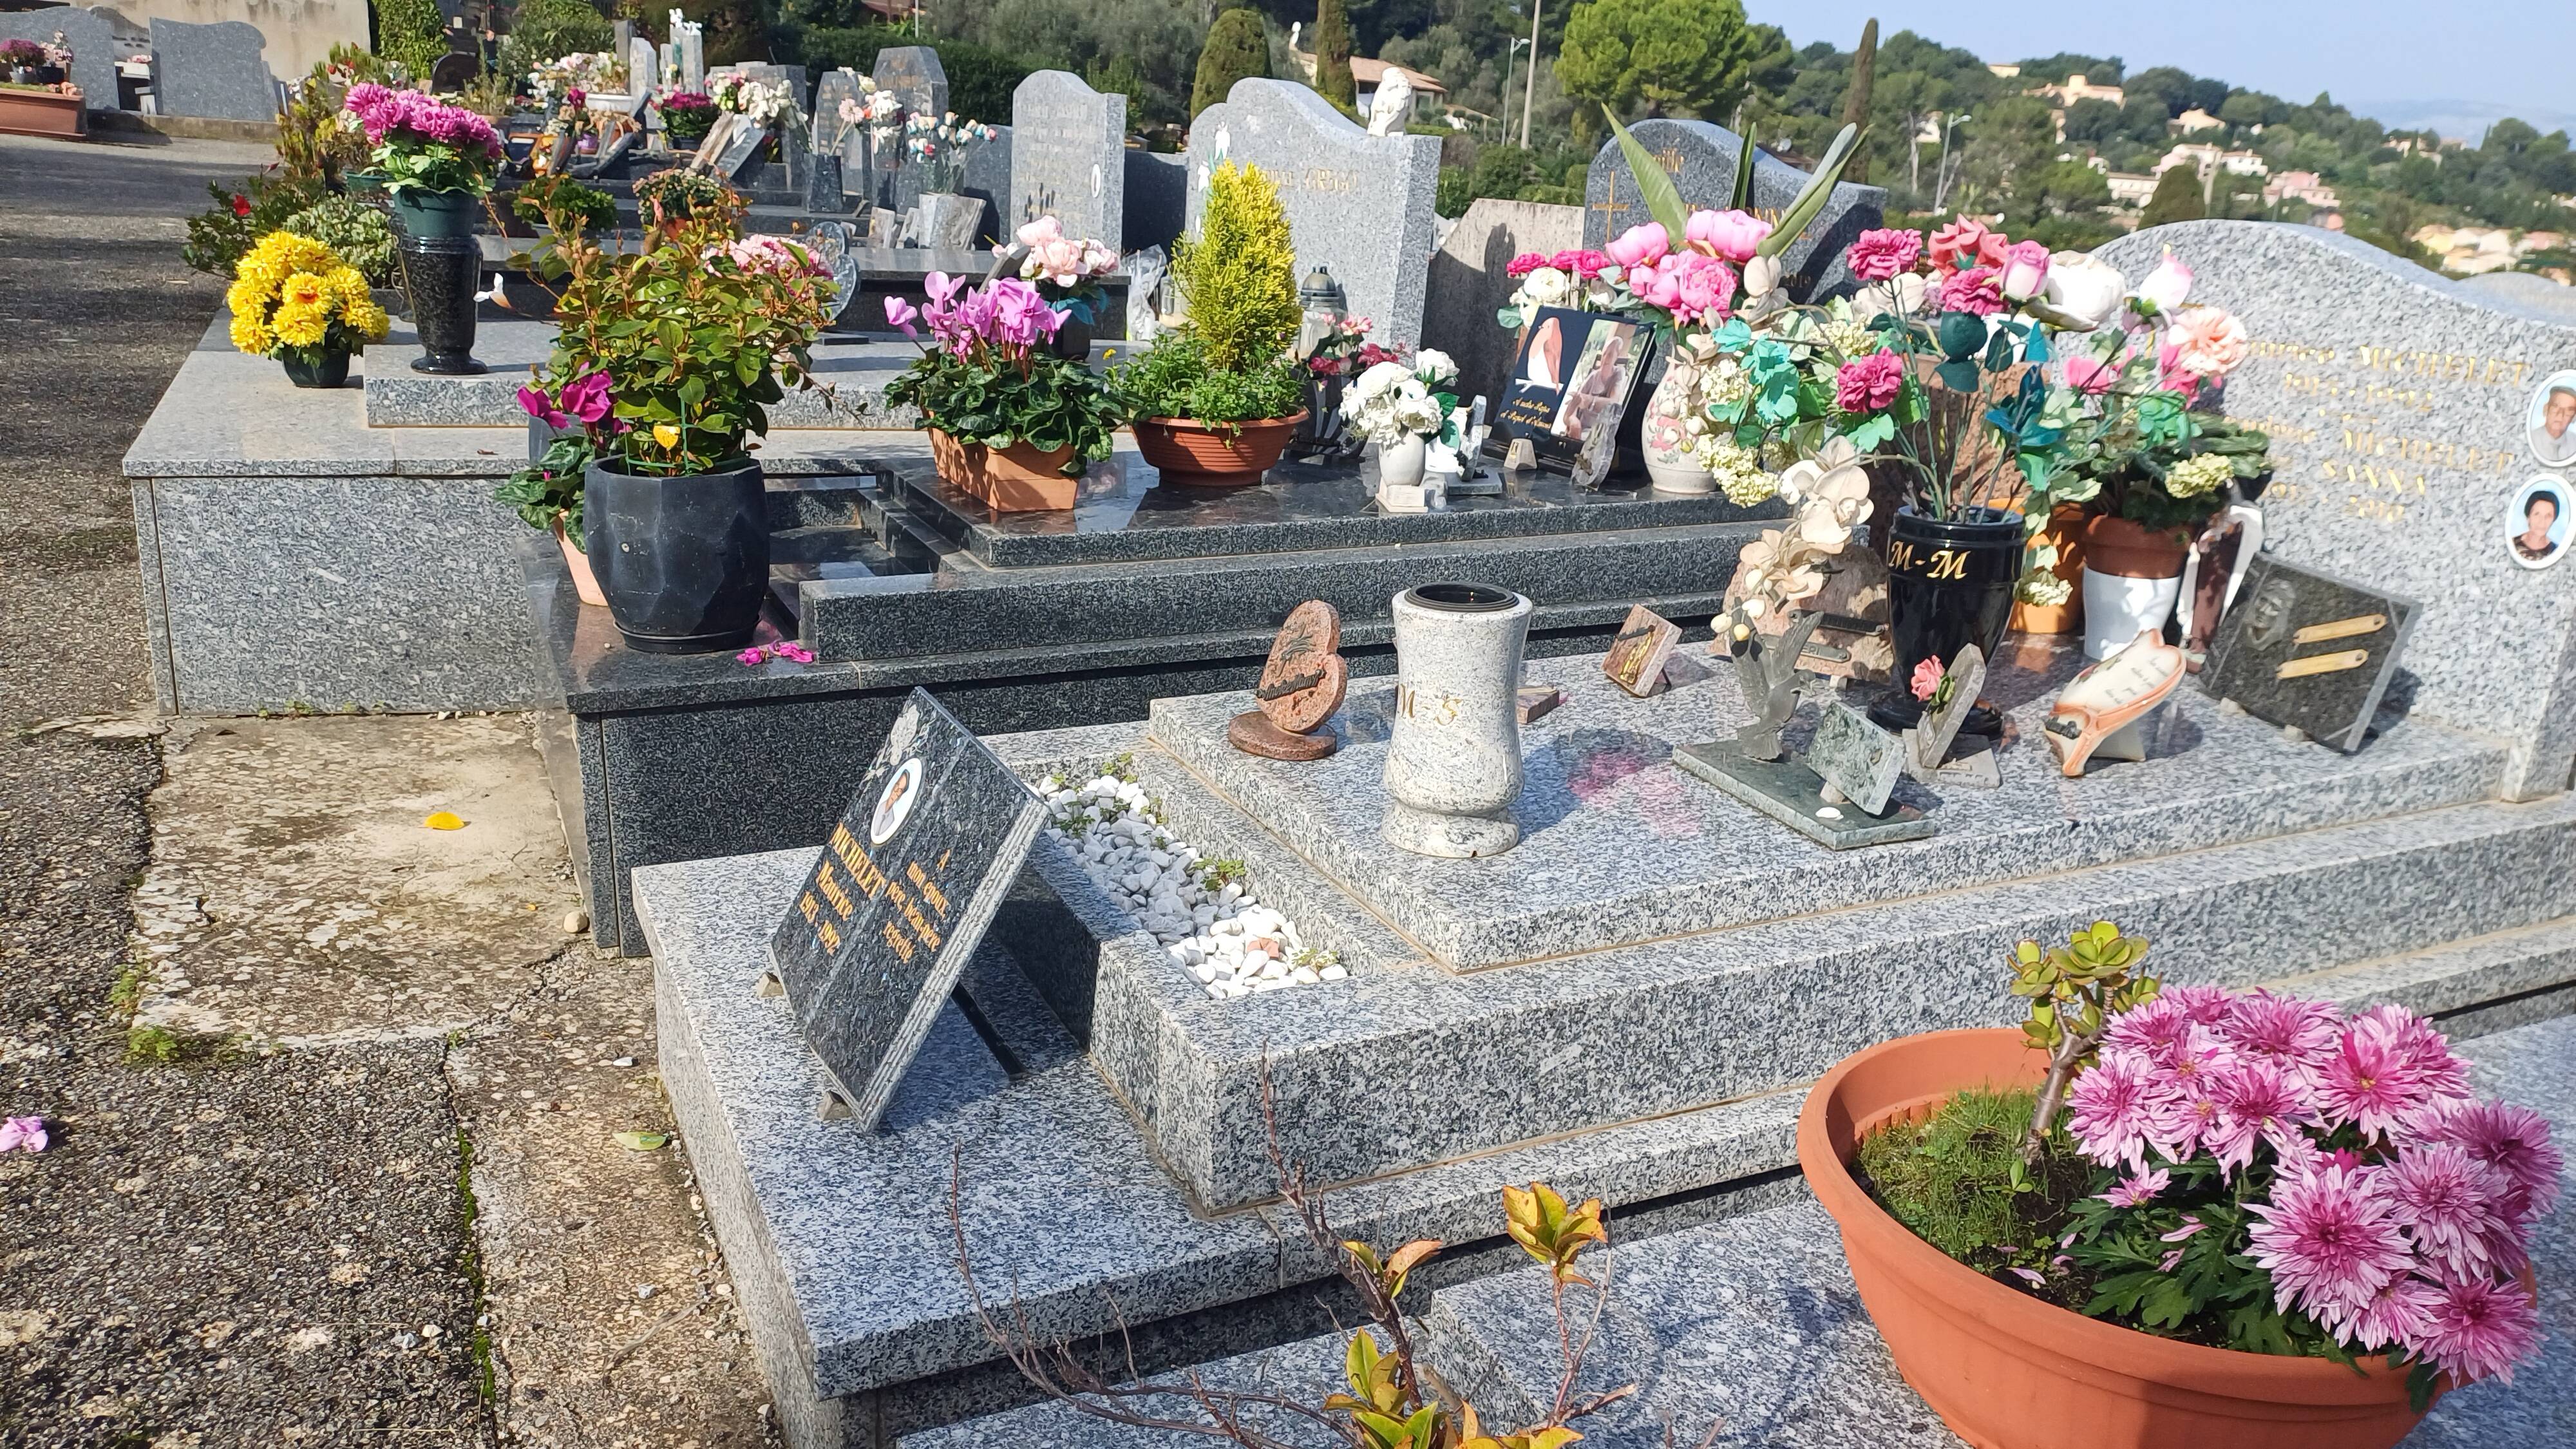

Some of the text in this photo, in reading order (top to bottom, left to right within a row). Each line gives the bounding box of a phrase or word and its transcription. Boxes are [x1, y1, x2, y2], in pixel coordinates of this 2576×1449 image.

[2358, 345, 2532, 387] MICHELET
[2343, 428, 2515, 475] MICHELET
[829, 822, 887, 900] MICHELET
[906, 860, 927, 889] mon
[937, 848, 951, 872] A
[815, 860, 853, 922] Maurice
[799, 891, 819, 924] 1913
[817, 919, 840, 956] 1992
[883, 920, 916, 964] regretté
